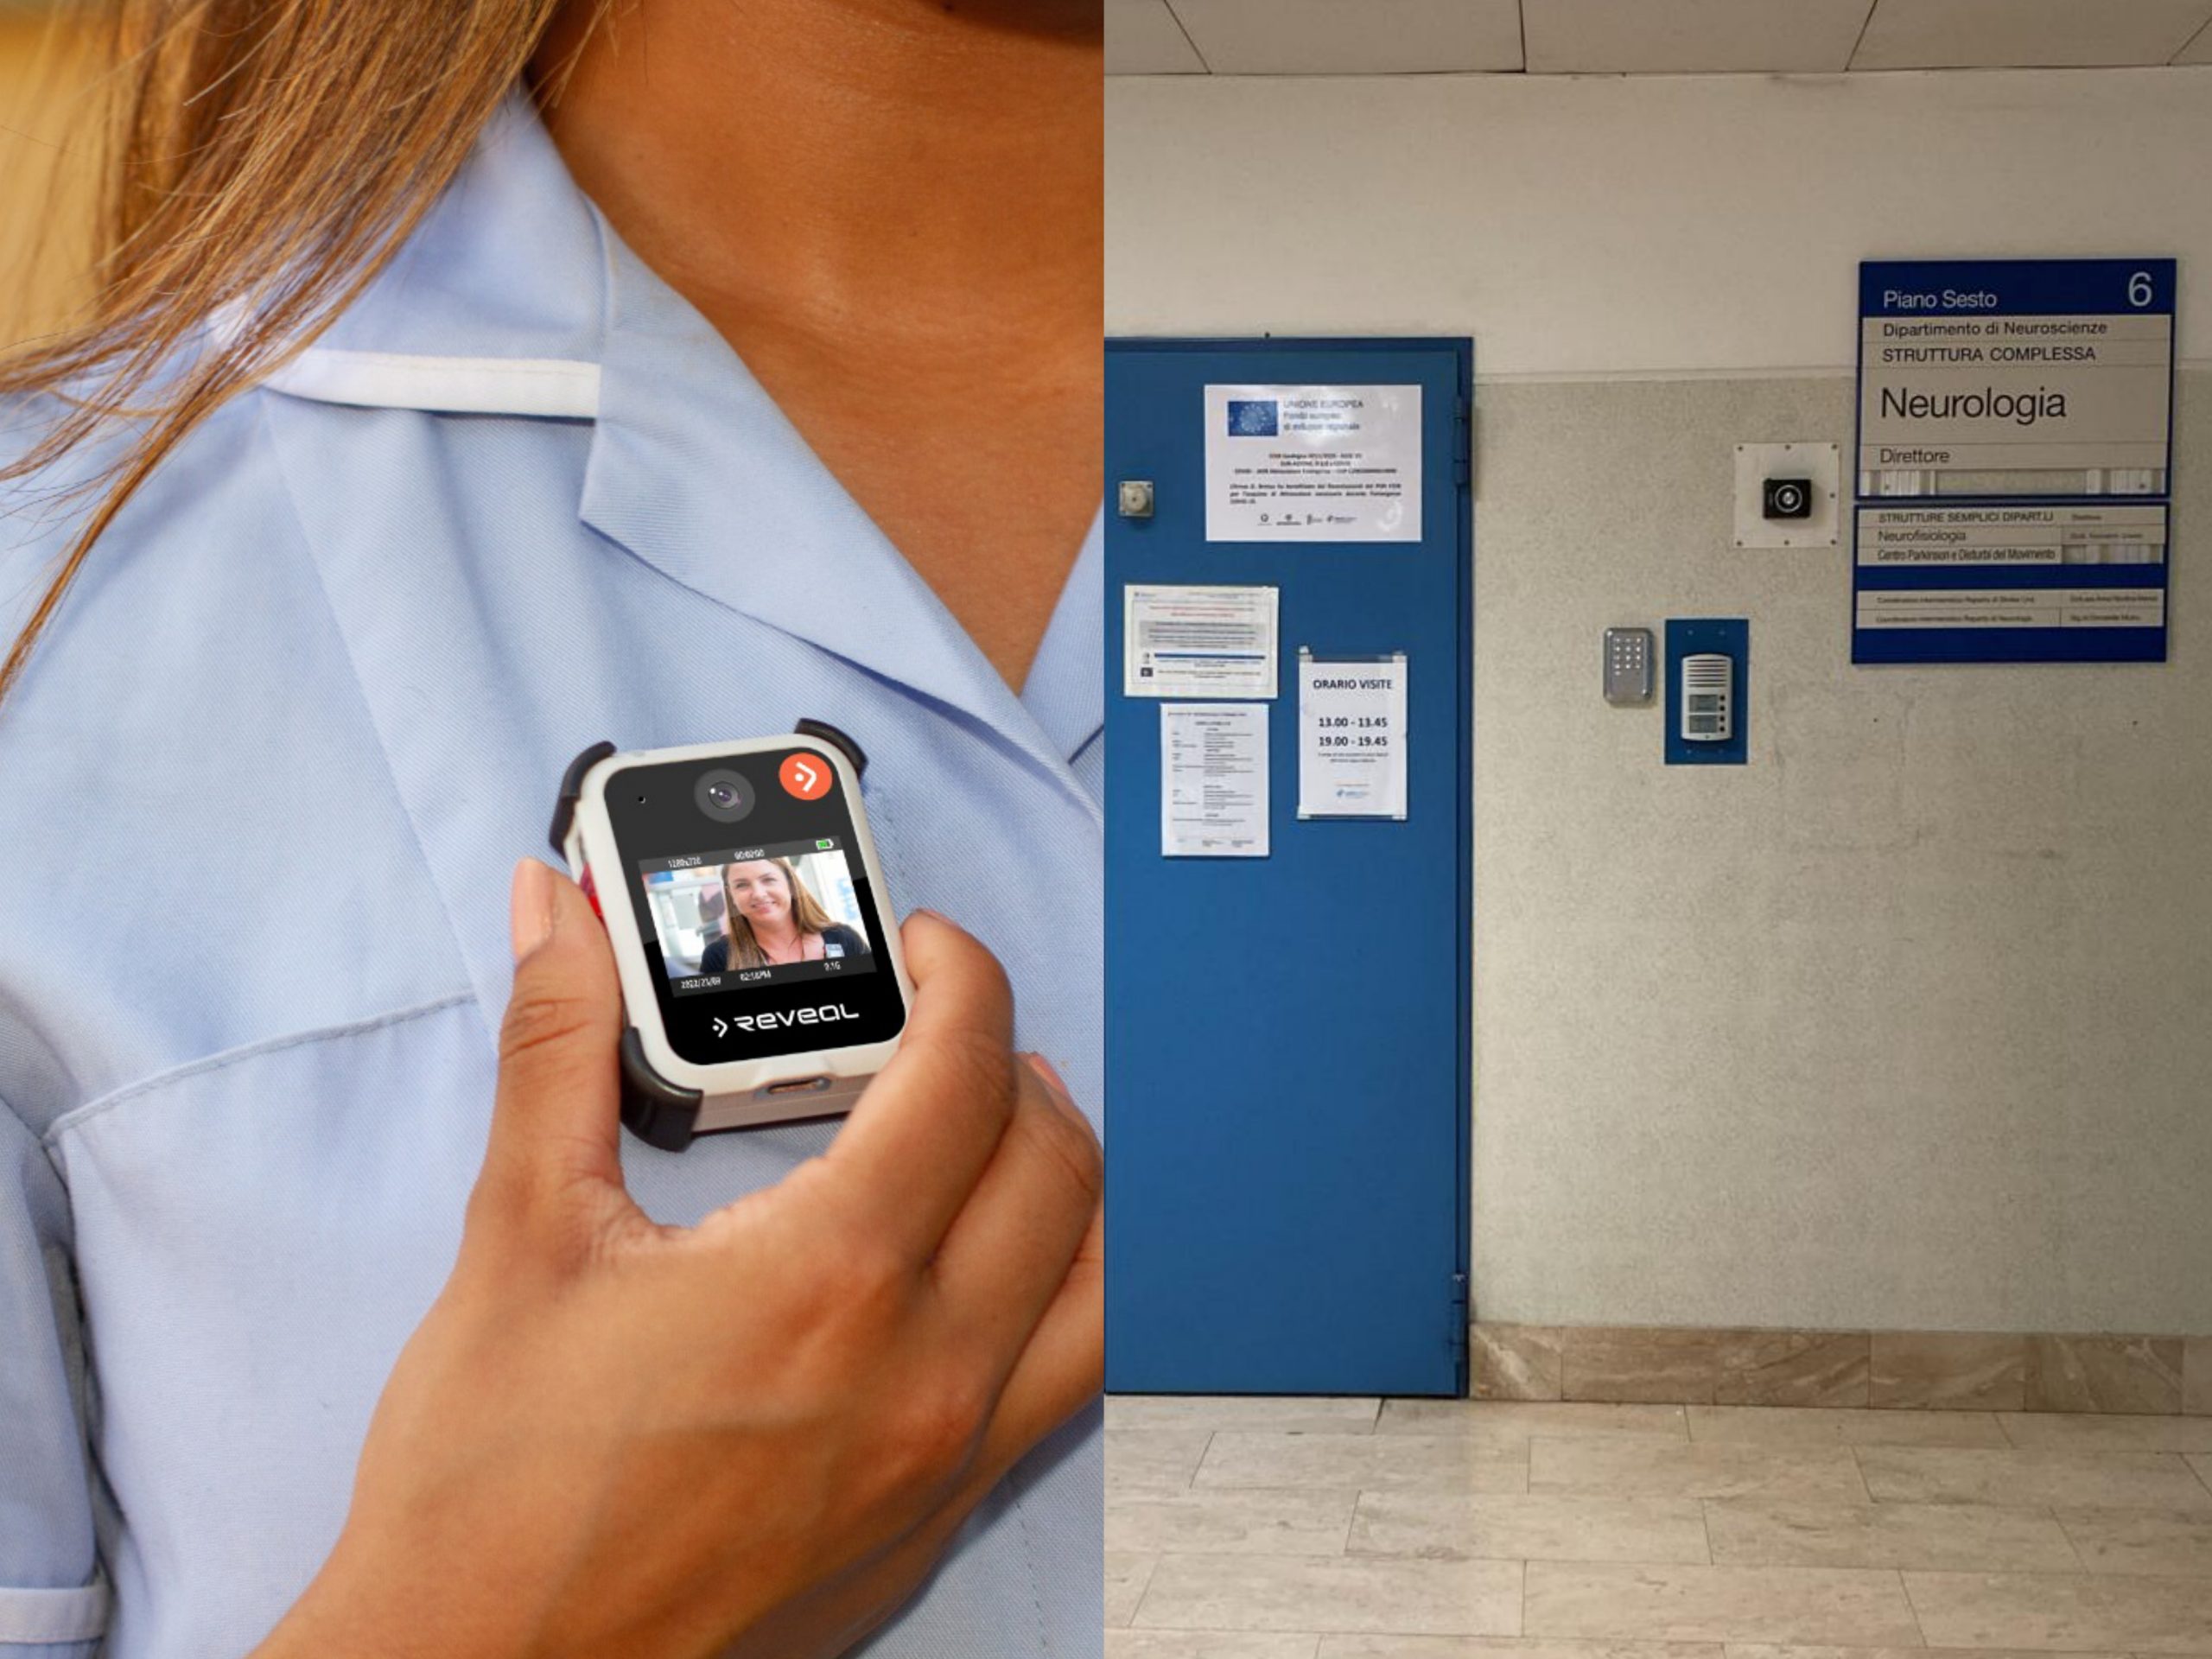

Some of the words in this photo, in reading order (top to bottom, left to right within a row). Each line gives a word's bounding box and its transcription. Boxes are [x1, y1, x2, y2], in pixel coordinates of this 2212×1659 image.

[2127, 271, 2153, 307] 6
[1883, 289, 1937, 308] Piano
[1942, 289, 1998, 308] Sesto
[1884, 322, 1981, 340] Dipartimento
[1985, 321, 1999, 334] di
[2004, 321, 2107, 335] Neuroscienze
[1883, 348, 1983, 362] STRUTTURA
[1990, 346, 2096, 361] COMPLESSA
[1881, 386, 2066, 425] Neurologia
[1880, 448, 1949, 464] Direttore
[1878, 513, 1944, 524] STRUTTURE
[1948, 512, 1999, 523] SEMPLICI
[1878, 530, 1967, 543] Neurofisiologia
[2008, 549, 2056, 560] Movimento
[1313, 679, 1357, 690] ORARIO
[1360, 679, 1392, 690] VISITE
[1319, 717, 1348, 728] 13.00
[1358, 717, 1388, 728] 13.45
[1319, 736, 1348, 747] 19.00
[1358, 736, 1388, 747] 19.45
[734, 1003, 860, 1032] REVEAL
